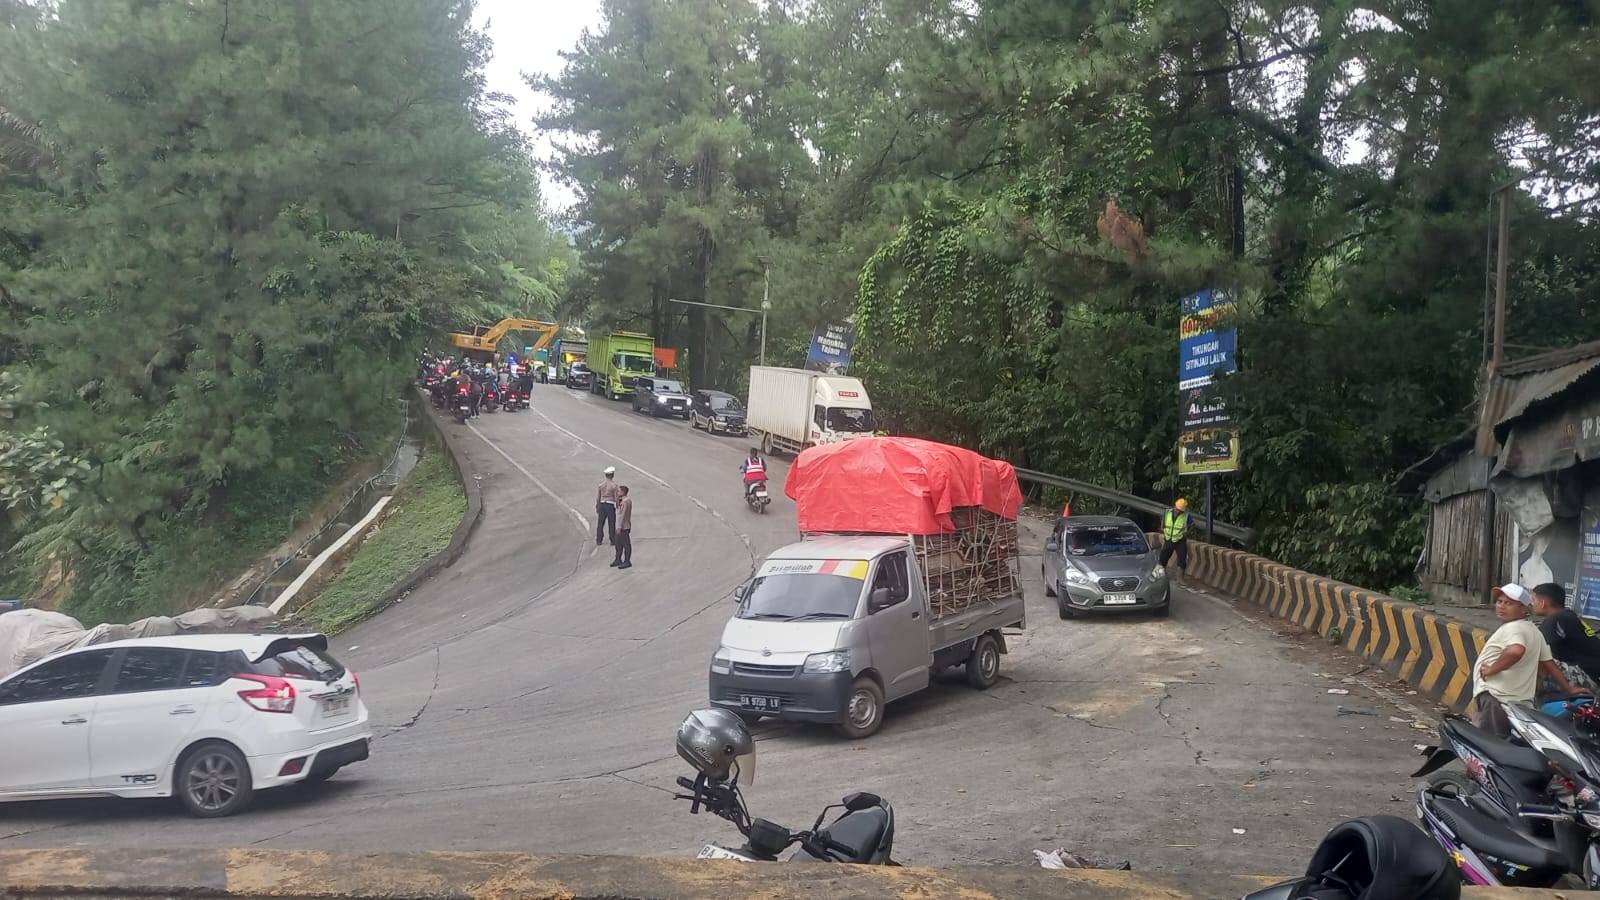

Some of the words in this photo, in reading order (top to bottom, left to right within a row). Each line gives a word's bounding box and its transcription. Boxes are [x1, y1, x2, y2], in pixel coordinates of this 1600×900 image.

[1192, 340, 1219, 356] TIKUNGAN
[1185, 355, 1209, 370] SITINJAU
[120, 774, 157, 784] TRD
[701, 846, 716, 858] BA
